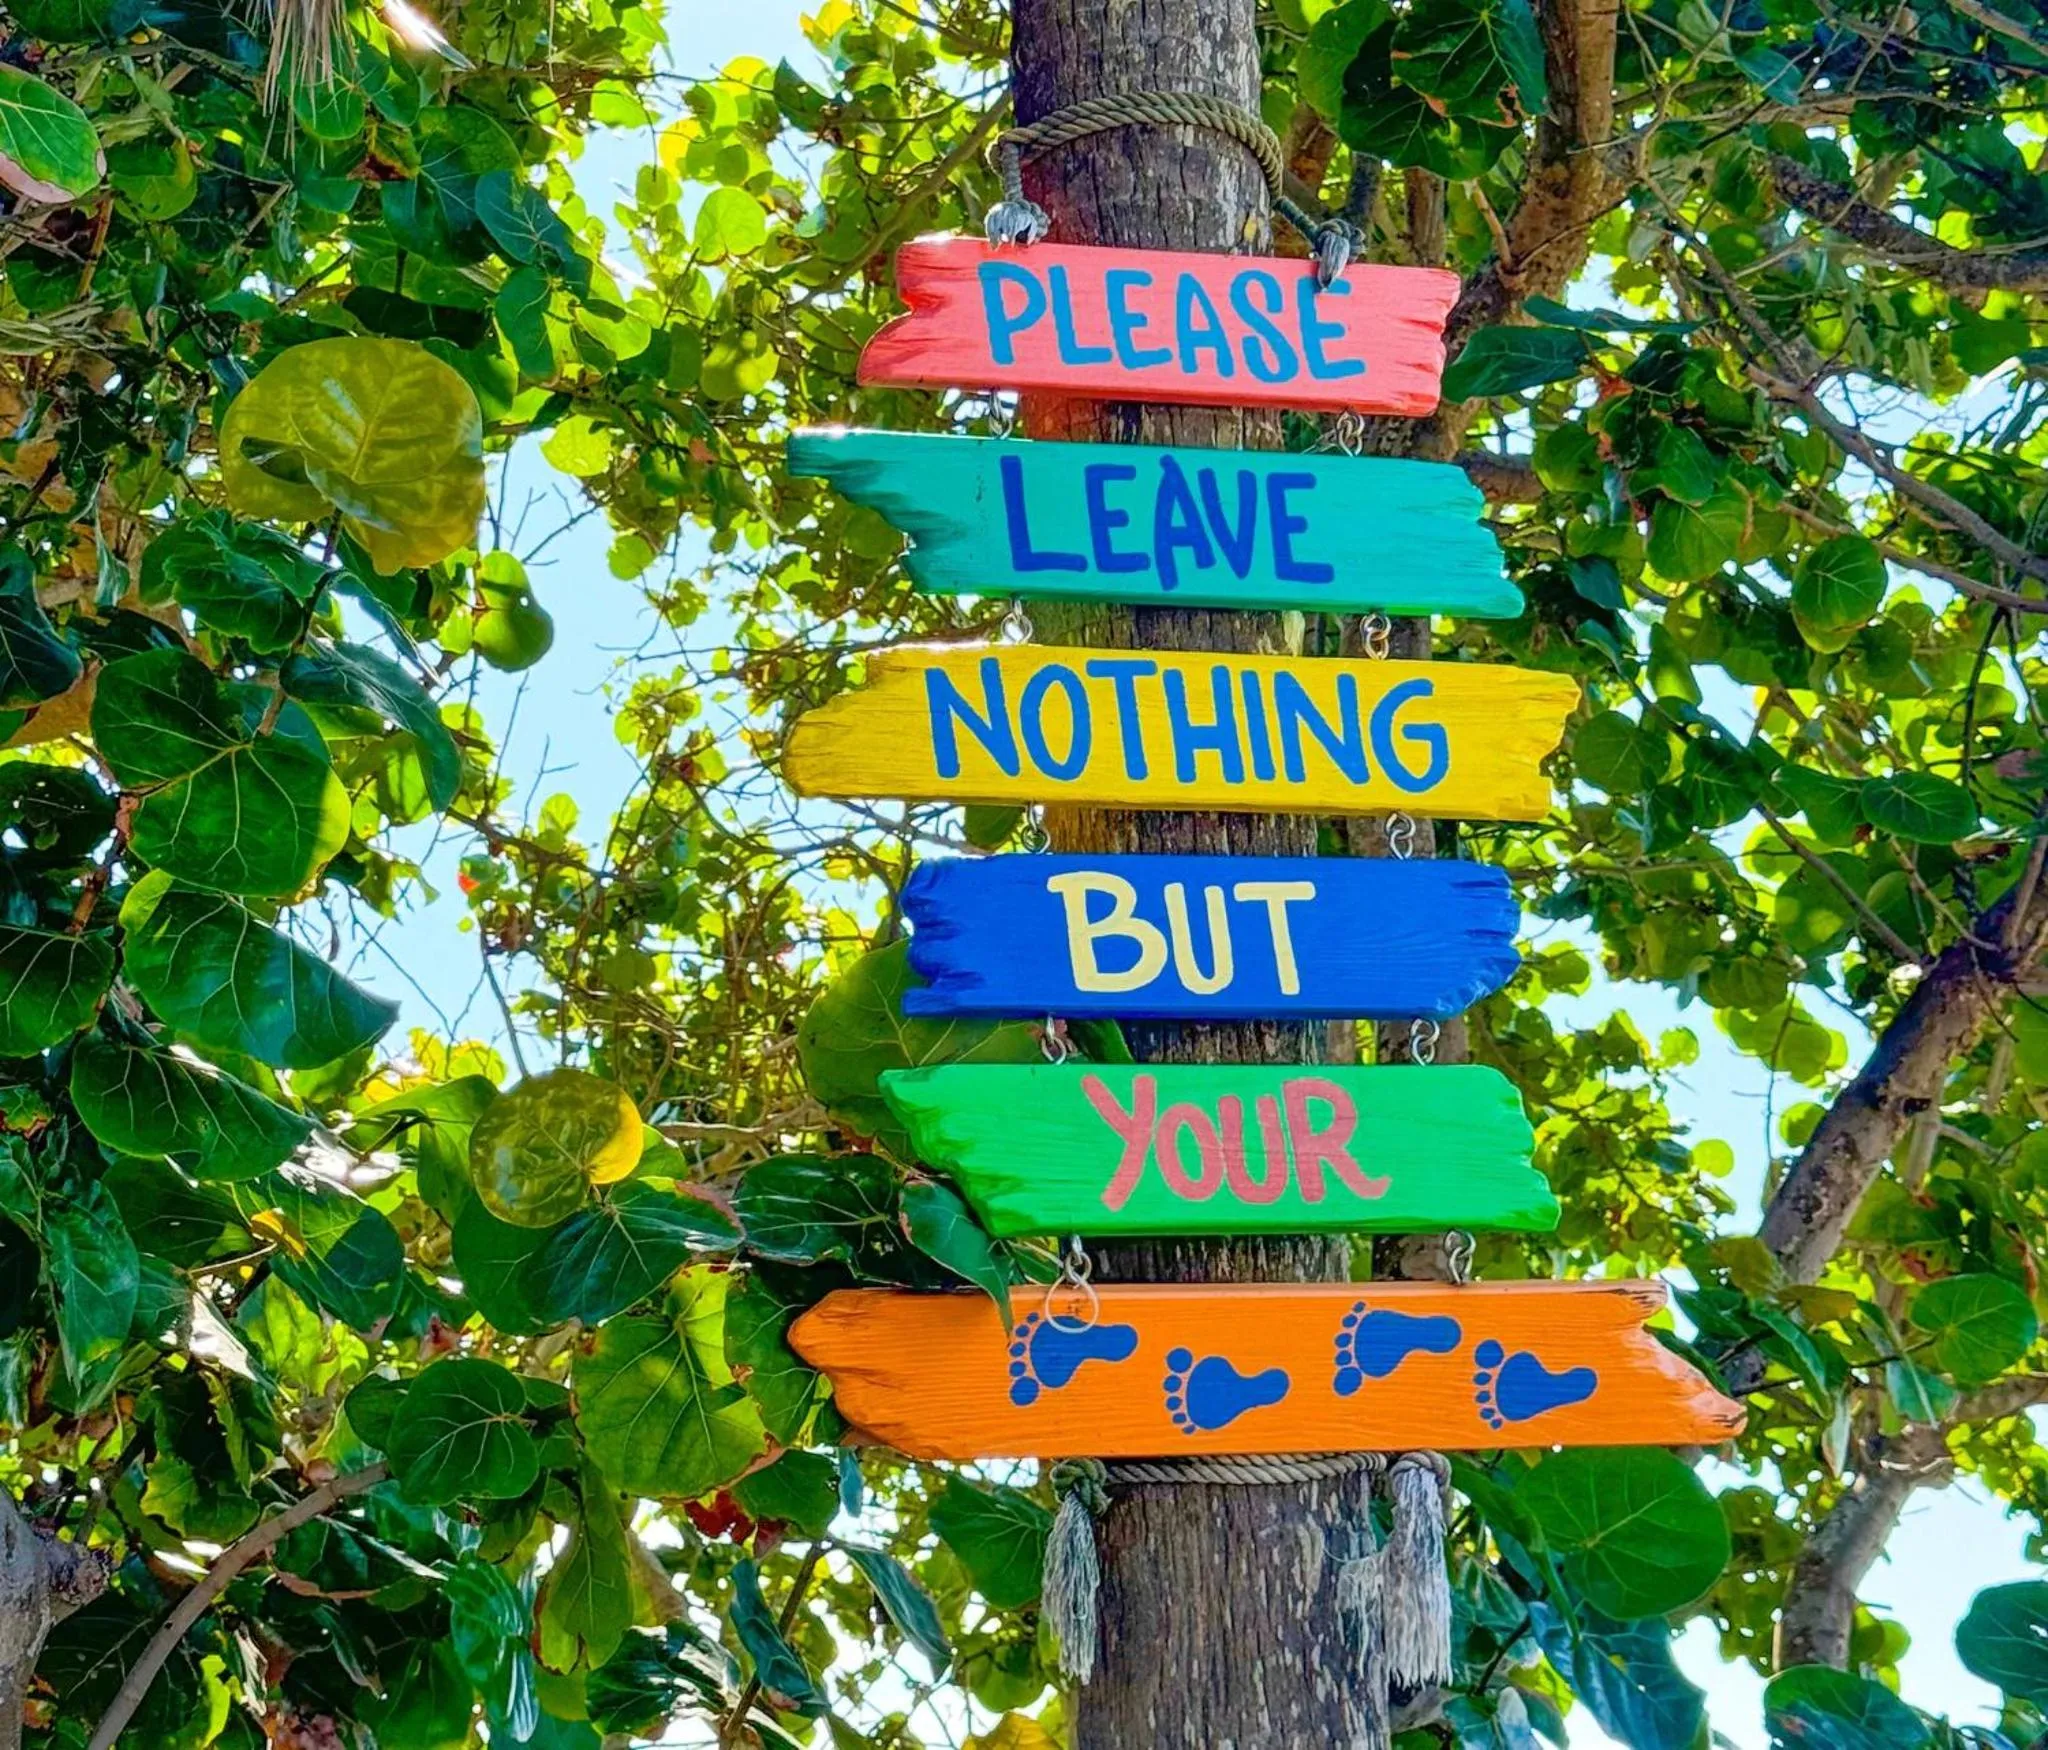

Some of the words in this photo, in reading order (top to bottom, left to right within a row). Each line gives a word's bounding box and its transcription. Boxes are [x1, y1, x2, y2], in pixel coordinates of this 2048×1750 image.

[978, 262, 1366, 384] PLEASE
[1000, 454, 1335, 591] LEAVE
[925, 657, 1450, 793] NOTHING
[1047, 871, 1316, 995] BUT
[1082, 1073, 1391, 1212] YOUR
